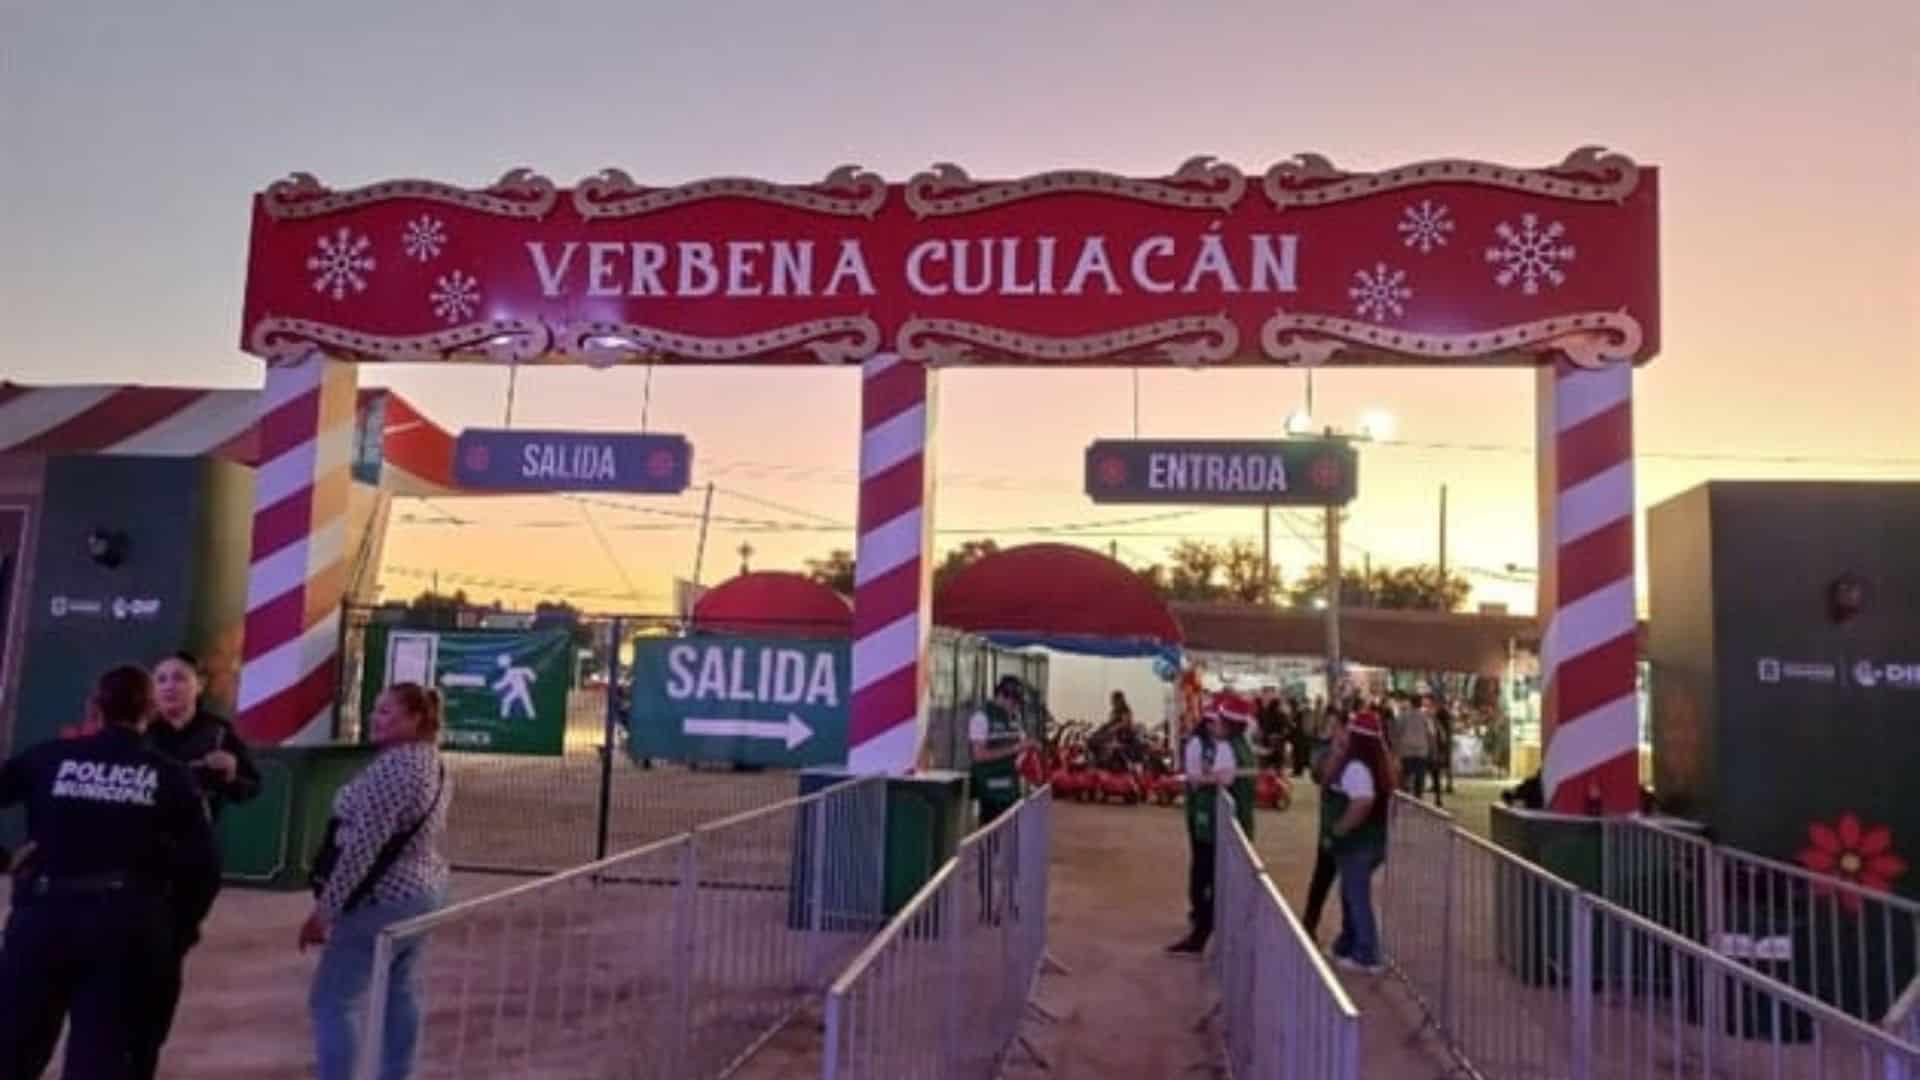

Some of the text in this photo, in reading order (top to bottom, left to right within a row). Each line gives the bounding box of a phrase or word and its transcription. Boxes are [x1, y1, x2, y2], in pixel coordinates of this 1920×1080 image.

[526, 220, 1300, 297] VERBENA CULIACÁN
[522, 443, 616, 480] SALIDA
[1148, 452, 1288, 492] ENTRADA
[666, 645, 839, 707] SALIDA
